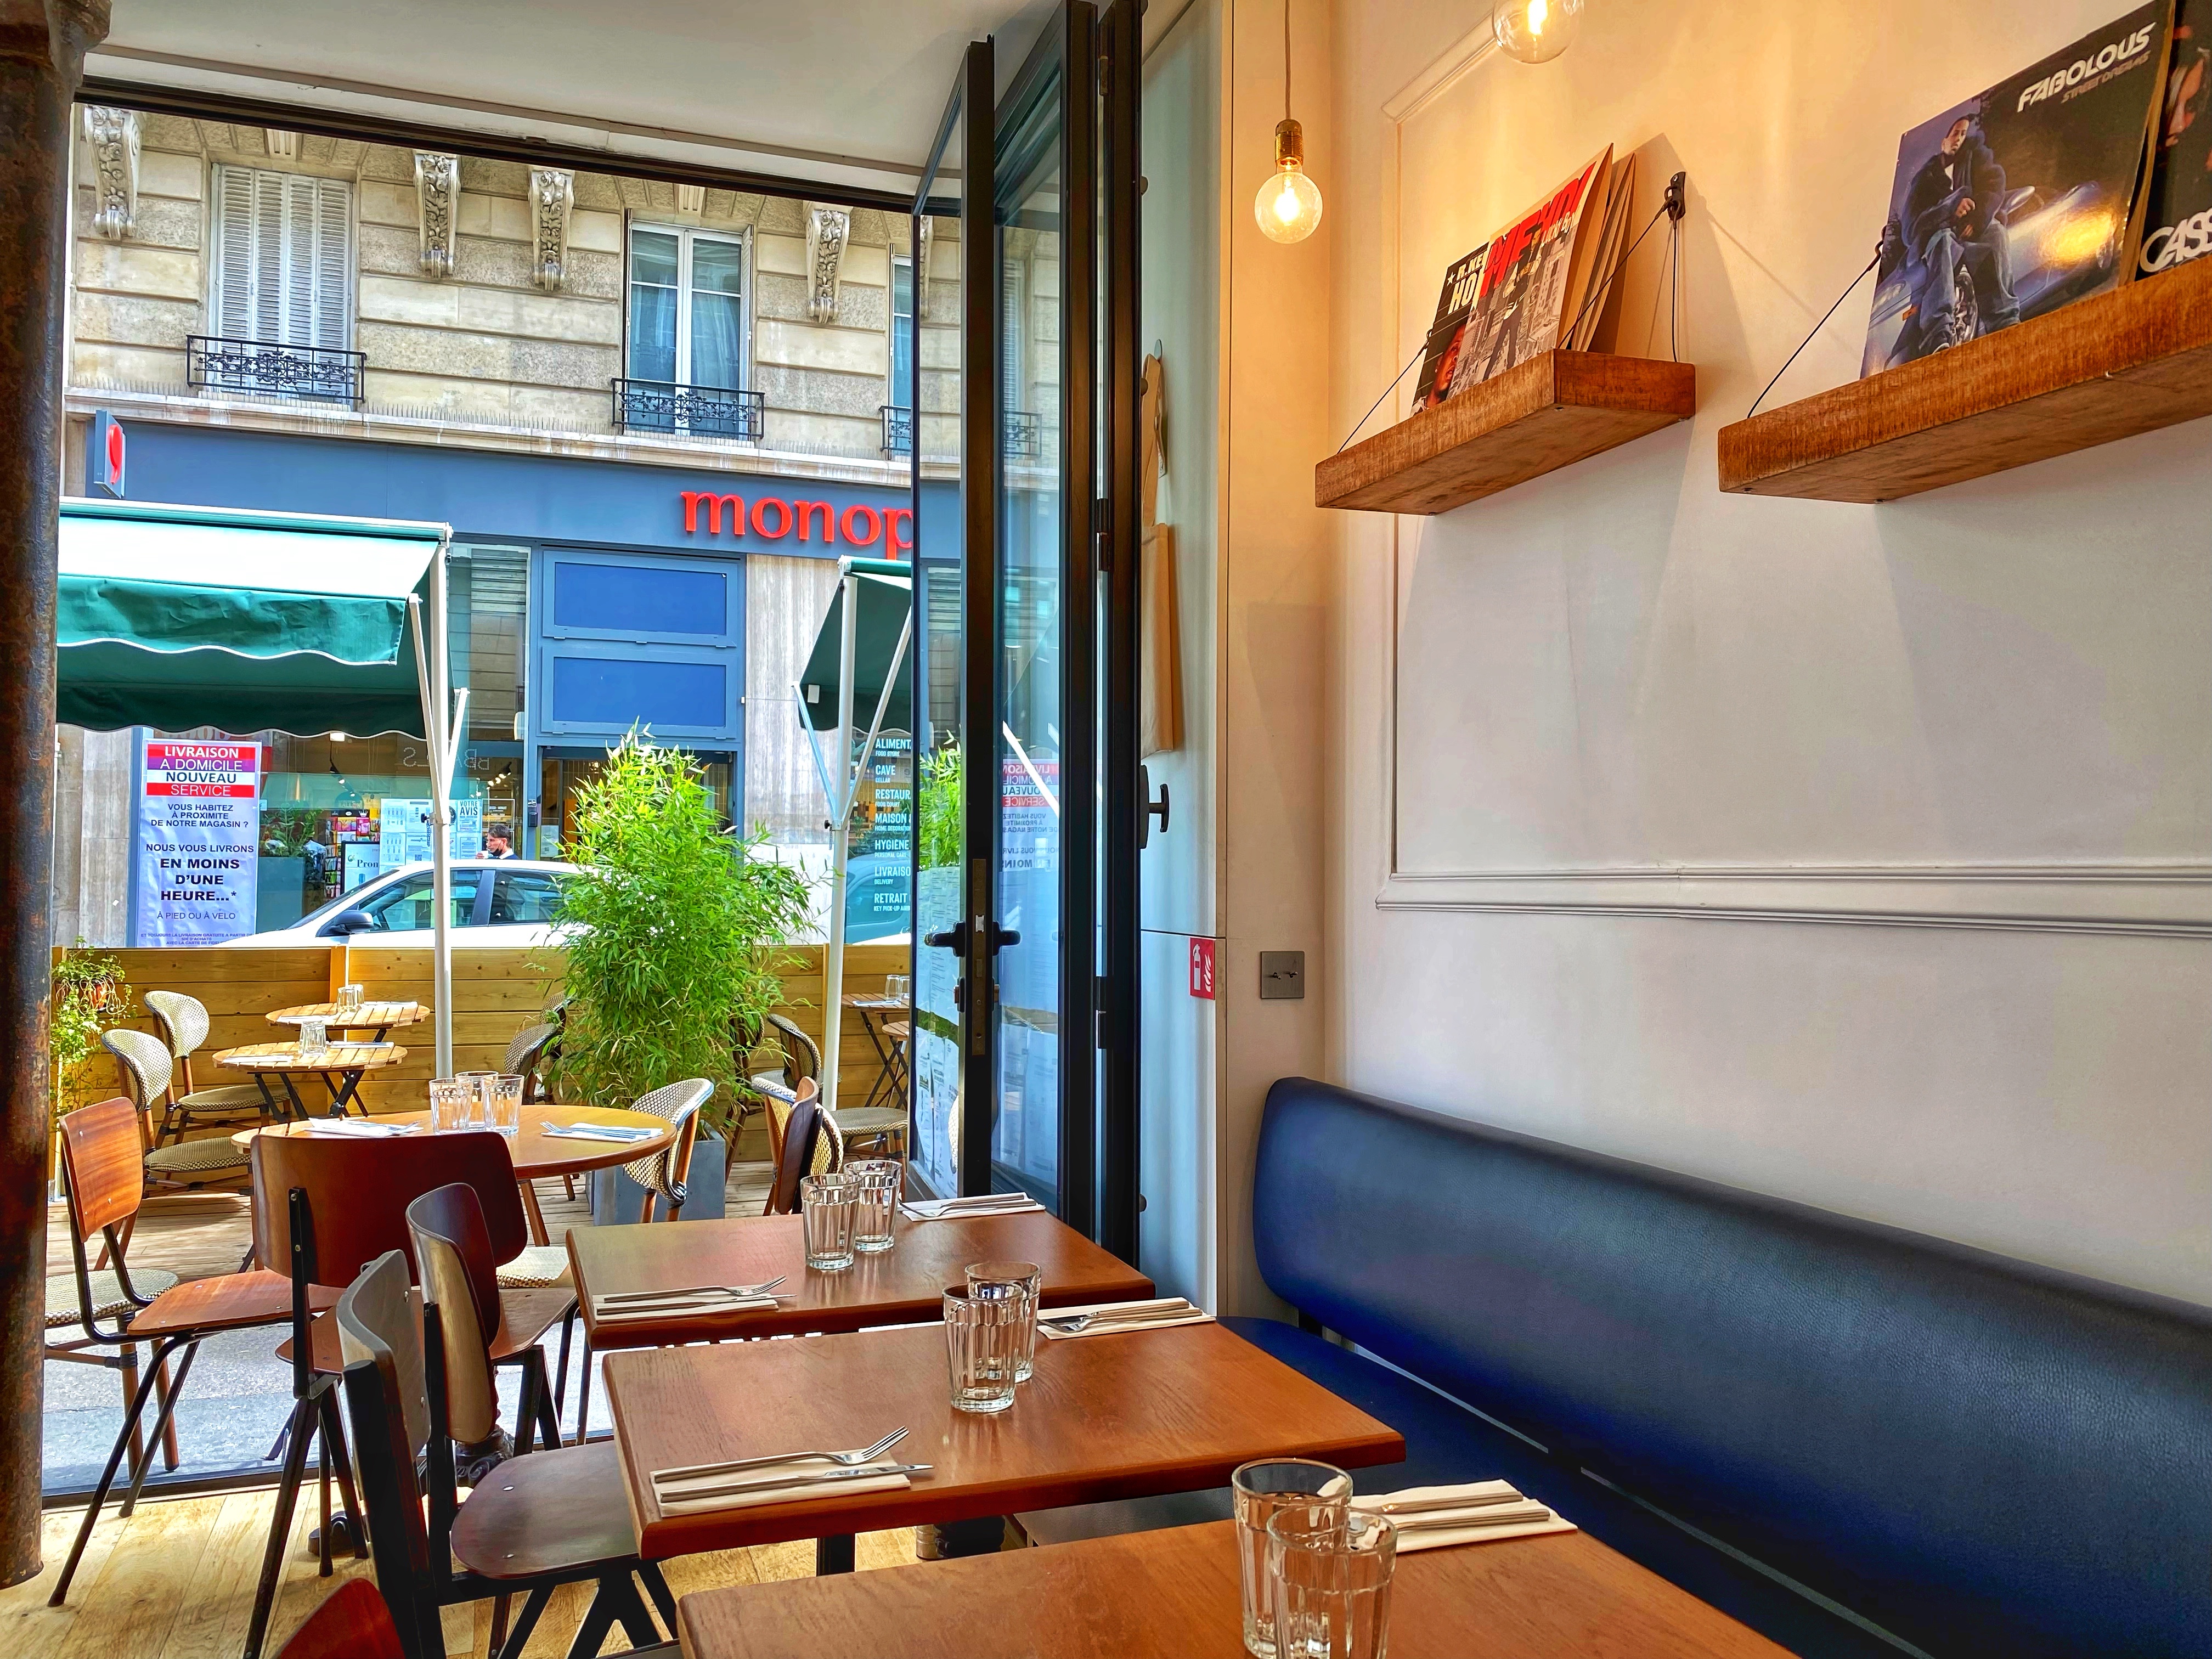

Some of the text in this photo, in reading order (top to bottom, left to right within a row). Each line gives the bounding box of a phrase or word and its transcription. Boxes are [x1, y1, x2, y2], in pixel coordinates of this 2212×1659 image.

[2017, 22, 2156, 112] FABOLOUS
[681, 492, 912, 560] monop
[875, 738, 912, 749] ALIMENT
[165, 746, 238, 758] LIVRAISON
[160, 758, 242, 771] A DOMICILE
[875, 764, 896, 775] CAVE
[166, 771, 236, 783] NOUVEAU
[171, 784, 231, 796] SERVICE
[875, 789, 911, 799] RESTAUR
[460, 806, 478, 816] AVIS
[875, 813, 907, 823] MAISON
[160, 859, 240, 869] EN MOINS
[176, 874, 223, 884] D'UNE
[874, 893, 908, 904] RETRAIT
